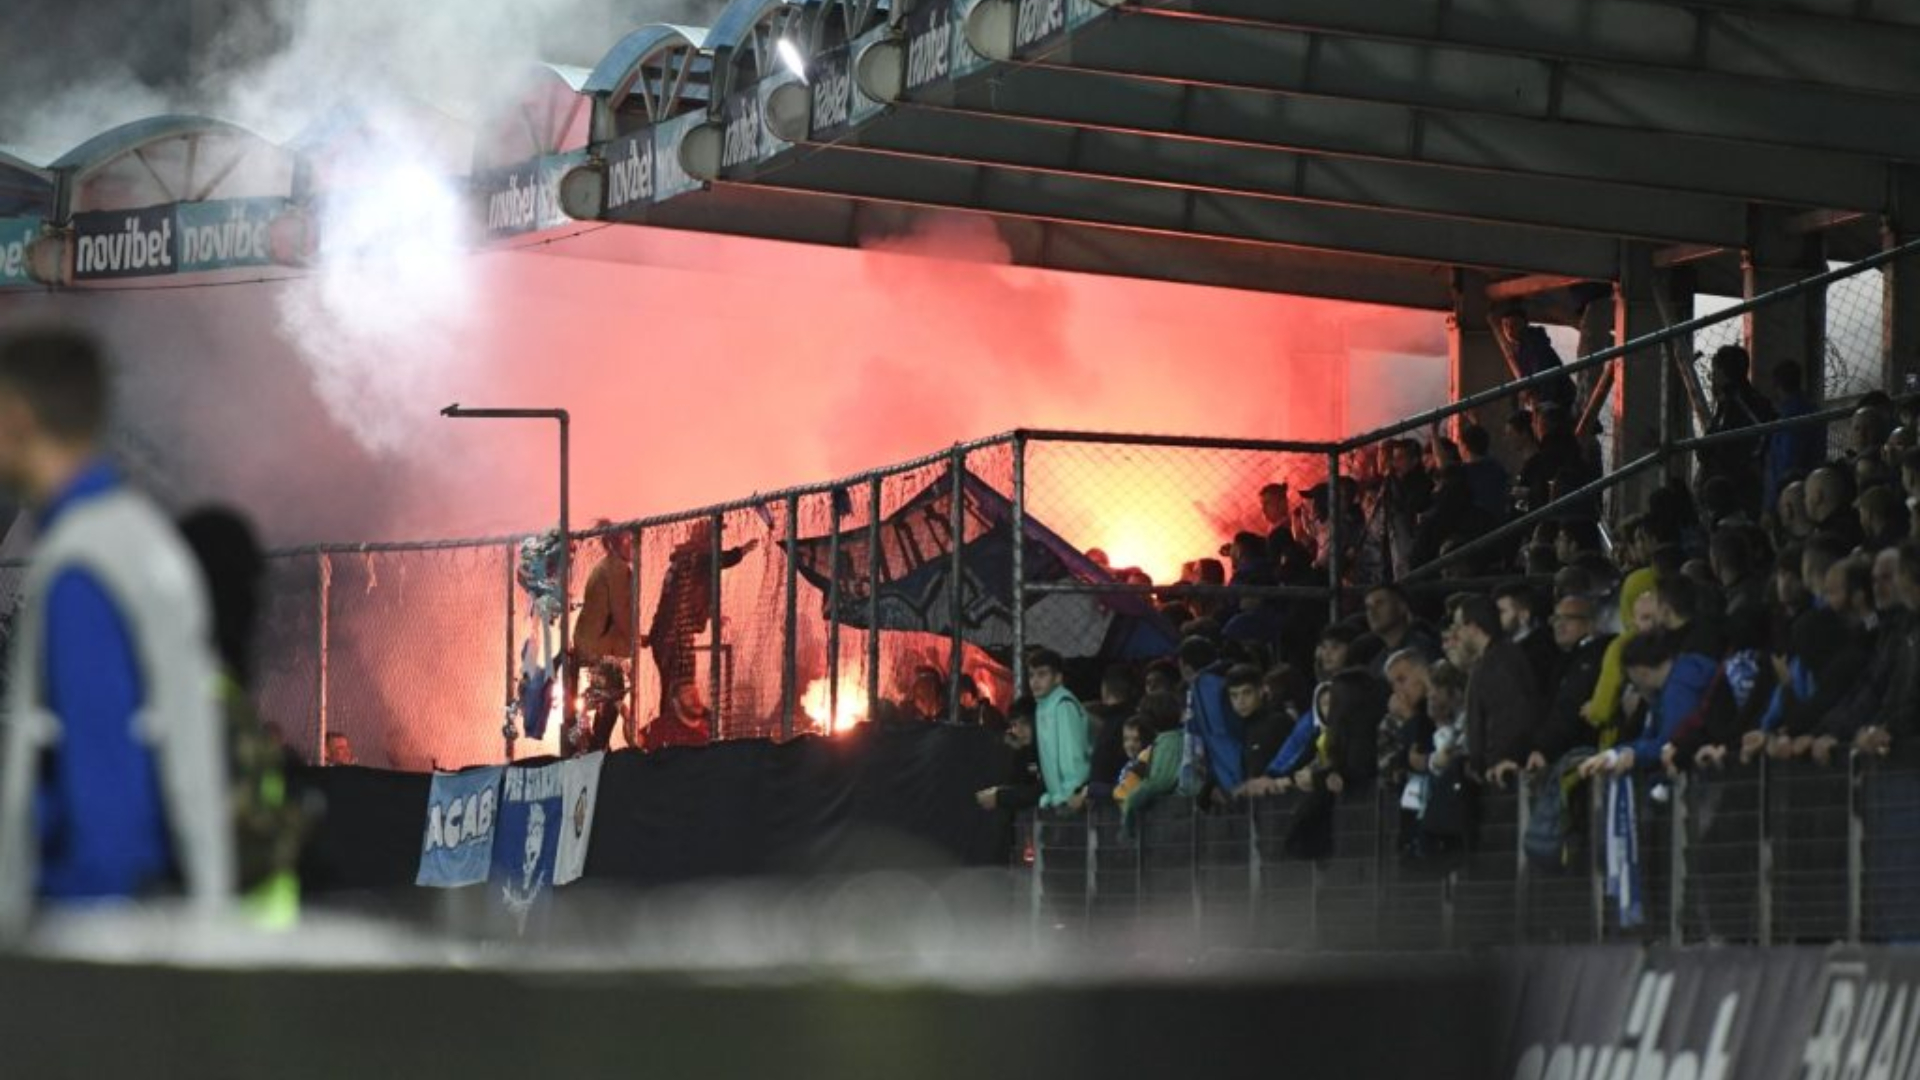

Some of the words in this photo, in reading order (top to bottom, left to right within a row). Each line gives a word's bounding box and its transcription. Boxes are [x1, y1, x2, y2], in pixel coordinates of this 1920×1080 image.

[77, 217, 171, 272] novibet
[183, 203, 276, 263] novibe
[426, 789, 493, 851] ACAB
